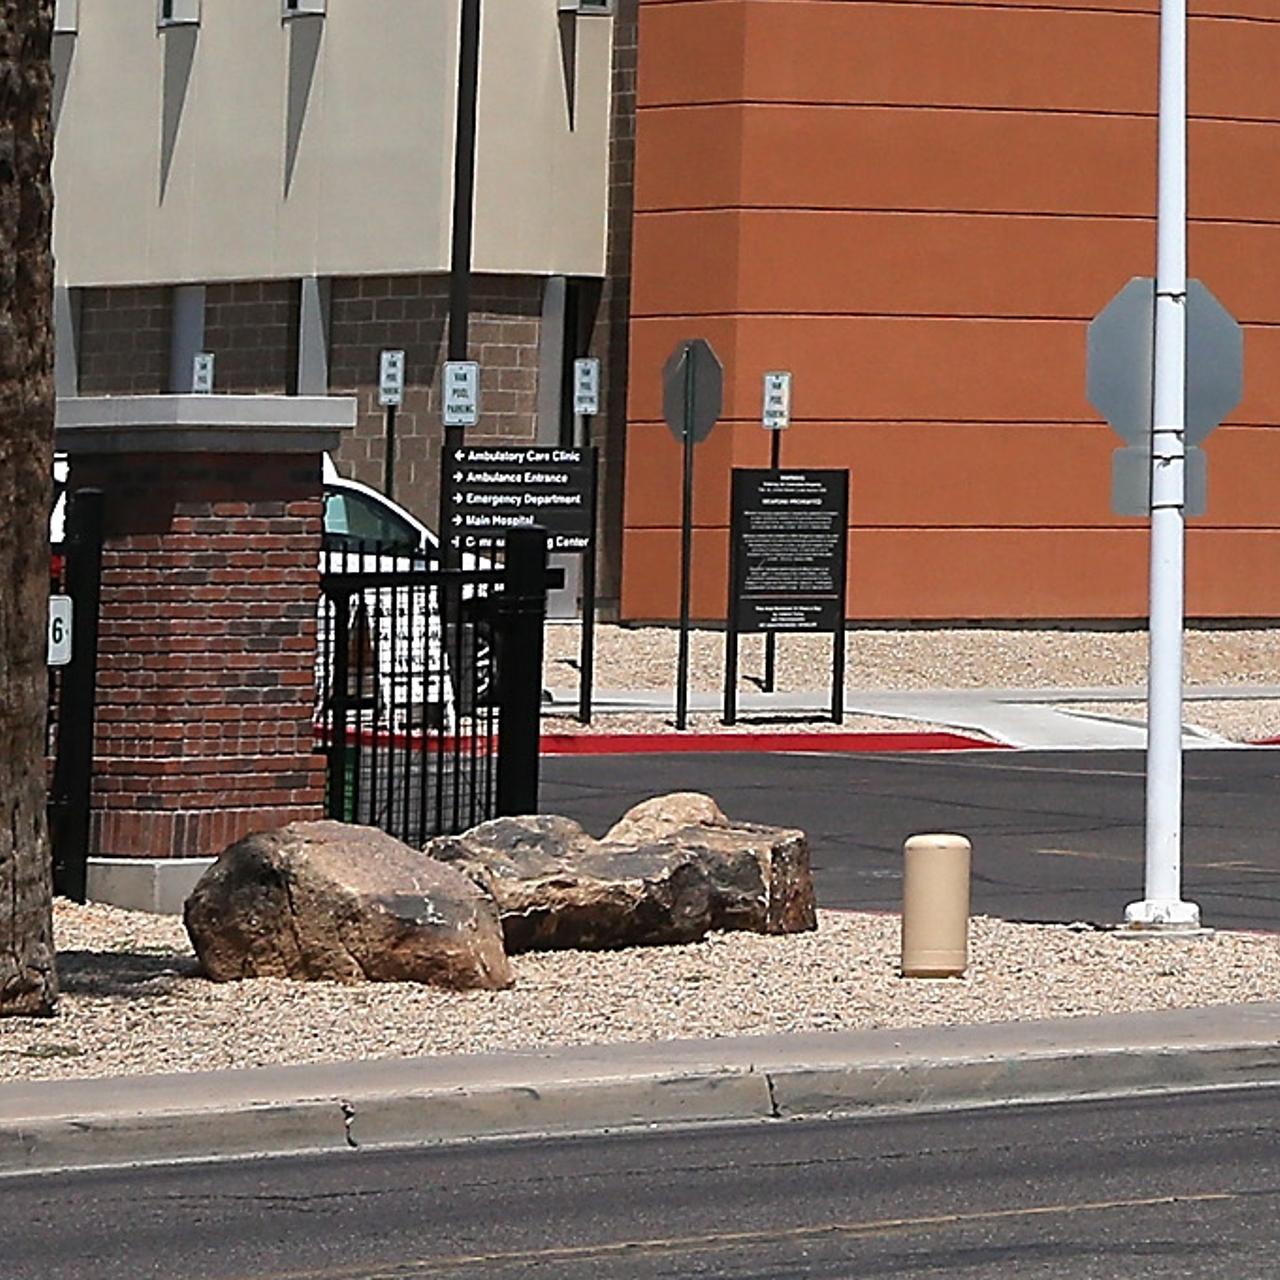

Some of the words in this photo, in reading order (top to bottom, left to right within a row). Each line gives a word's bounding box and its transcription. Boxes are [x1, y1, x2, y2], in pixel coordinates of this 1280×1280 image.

[467, 450, 525, 464] Ambulatory
[526, 450, 550, 462] Care
[552, 450, 581, 462] Clinic
[466, 472, 522, 483] Ambulance
[523, 472, 568, 483] Entrance
[465, 492, 522, 507] Emergency
[524, 493, 581, 506] Department
[465, 515, 491, 526] Main
[492, 515, 534, 528] Hospital
[556, 536, 589, 547] Center
